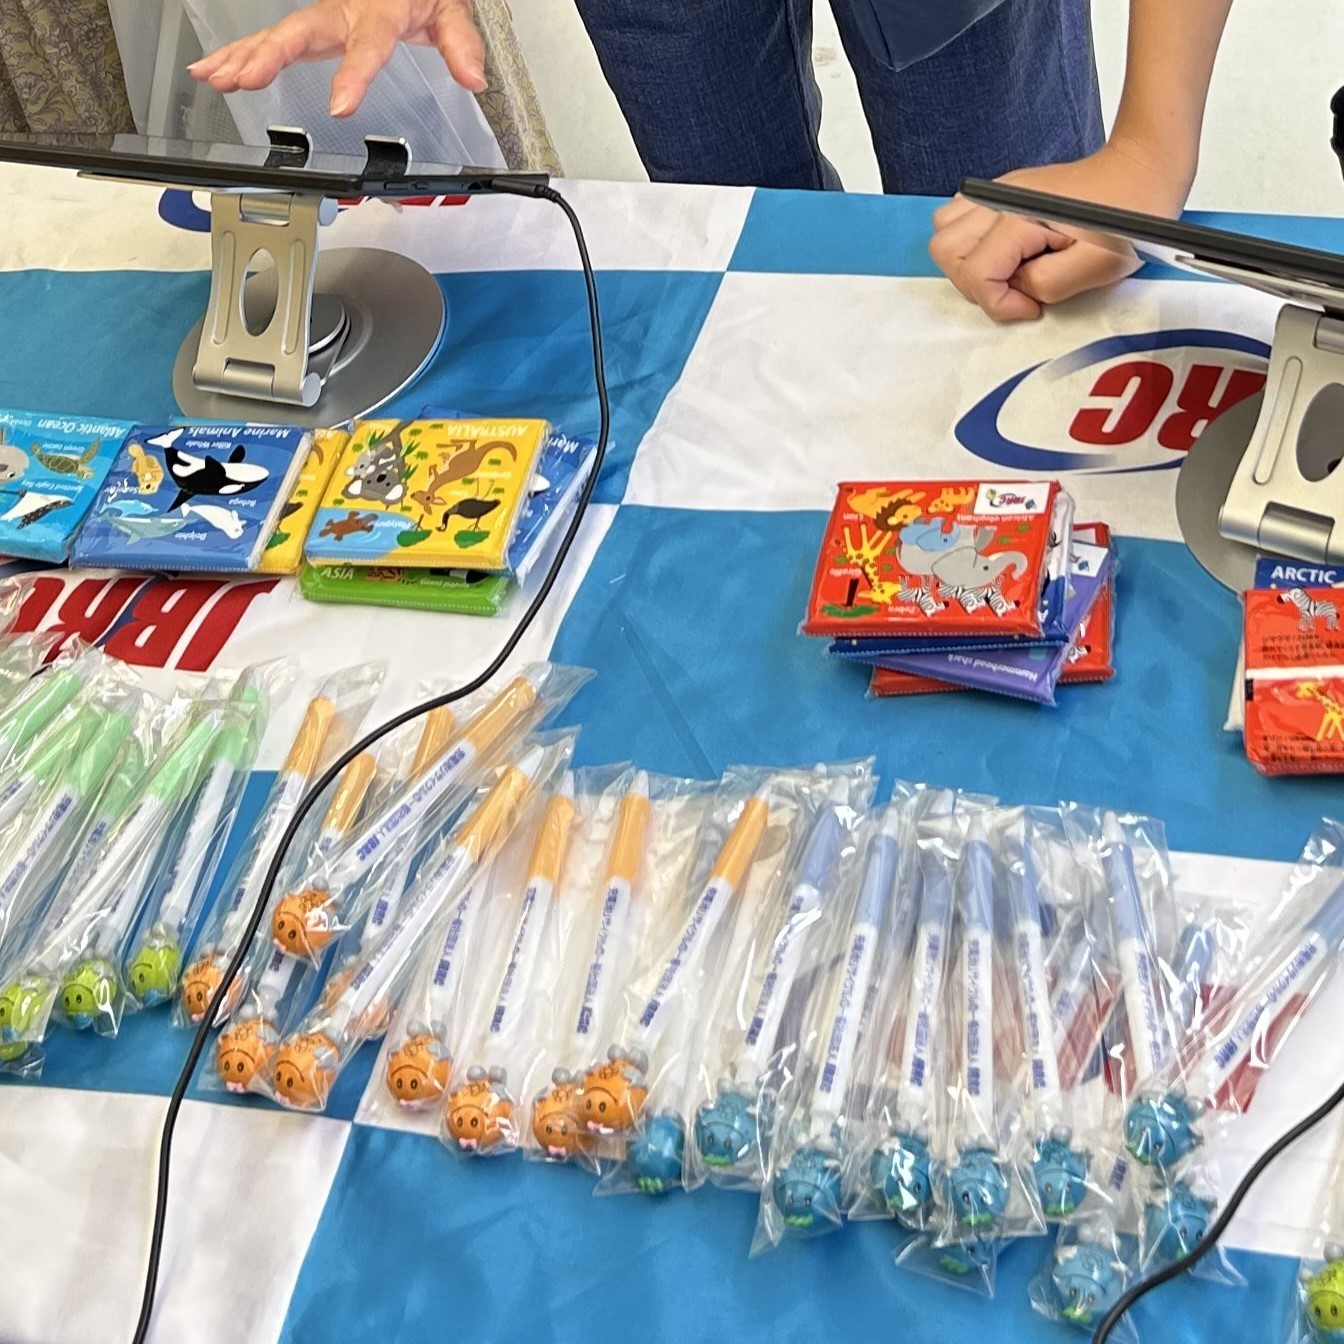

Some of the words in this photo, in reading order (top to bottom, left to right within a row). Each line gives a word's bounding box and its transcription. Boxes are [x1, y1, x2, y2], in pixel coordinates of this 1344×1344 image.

[1068, 360, 1267, 453] RC
[37, 419, 76, 434] Ocean
[78, 422, 126, 438] Atlantic
[187, 425, 244, 438] Animals
[246, 427, 291, 438] Marine
[448, 424, 529, 437] AUSTRALIA
[548, 434, 579, 454] Mari
[174, 530, 208, 542] Dolphin
[321, 567, 356, 581] ASIA
[1270, 564, 1337, 584] ARCTIC
[947, 653, 975, 668] shark
[975, 660, 1039, 681] Hammerhead
[353, 832, 382, 862] JBRC
